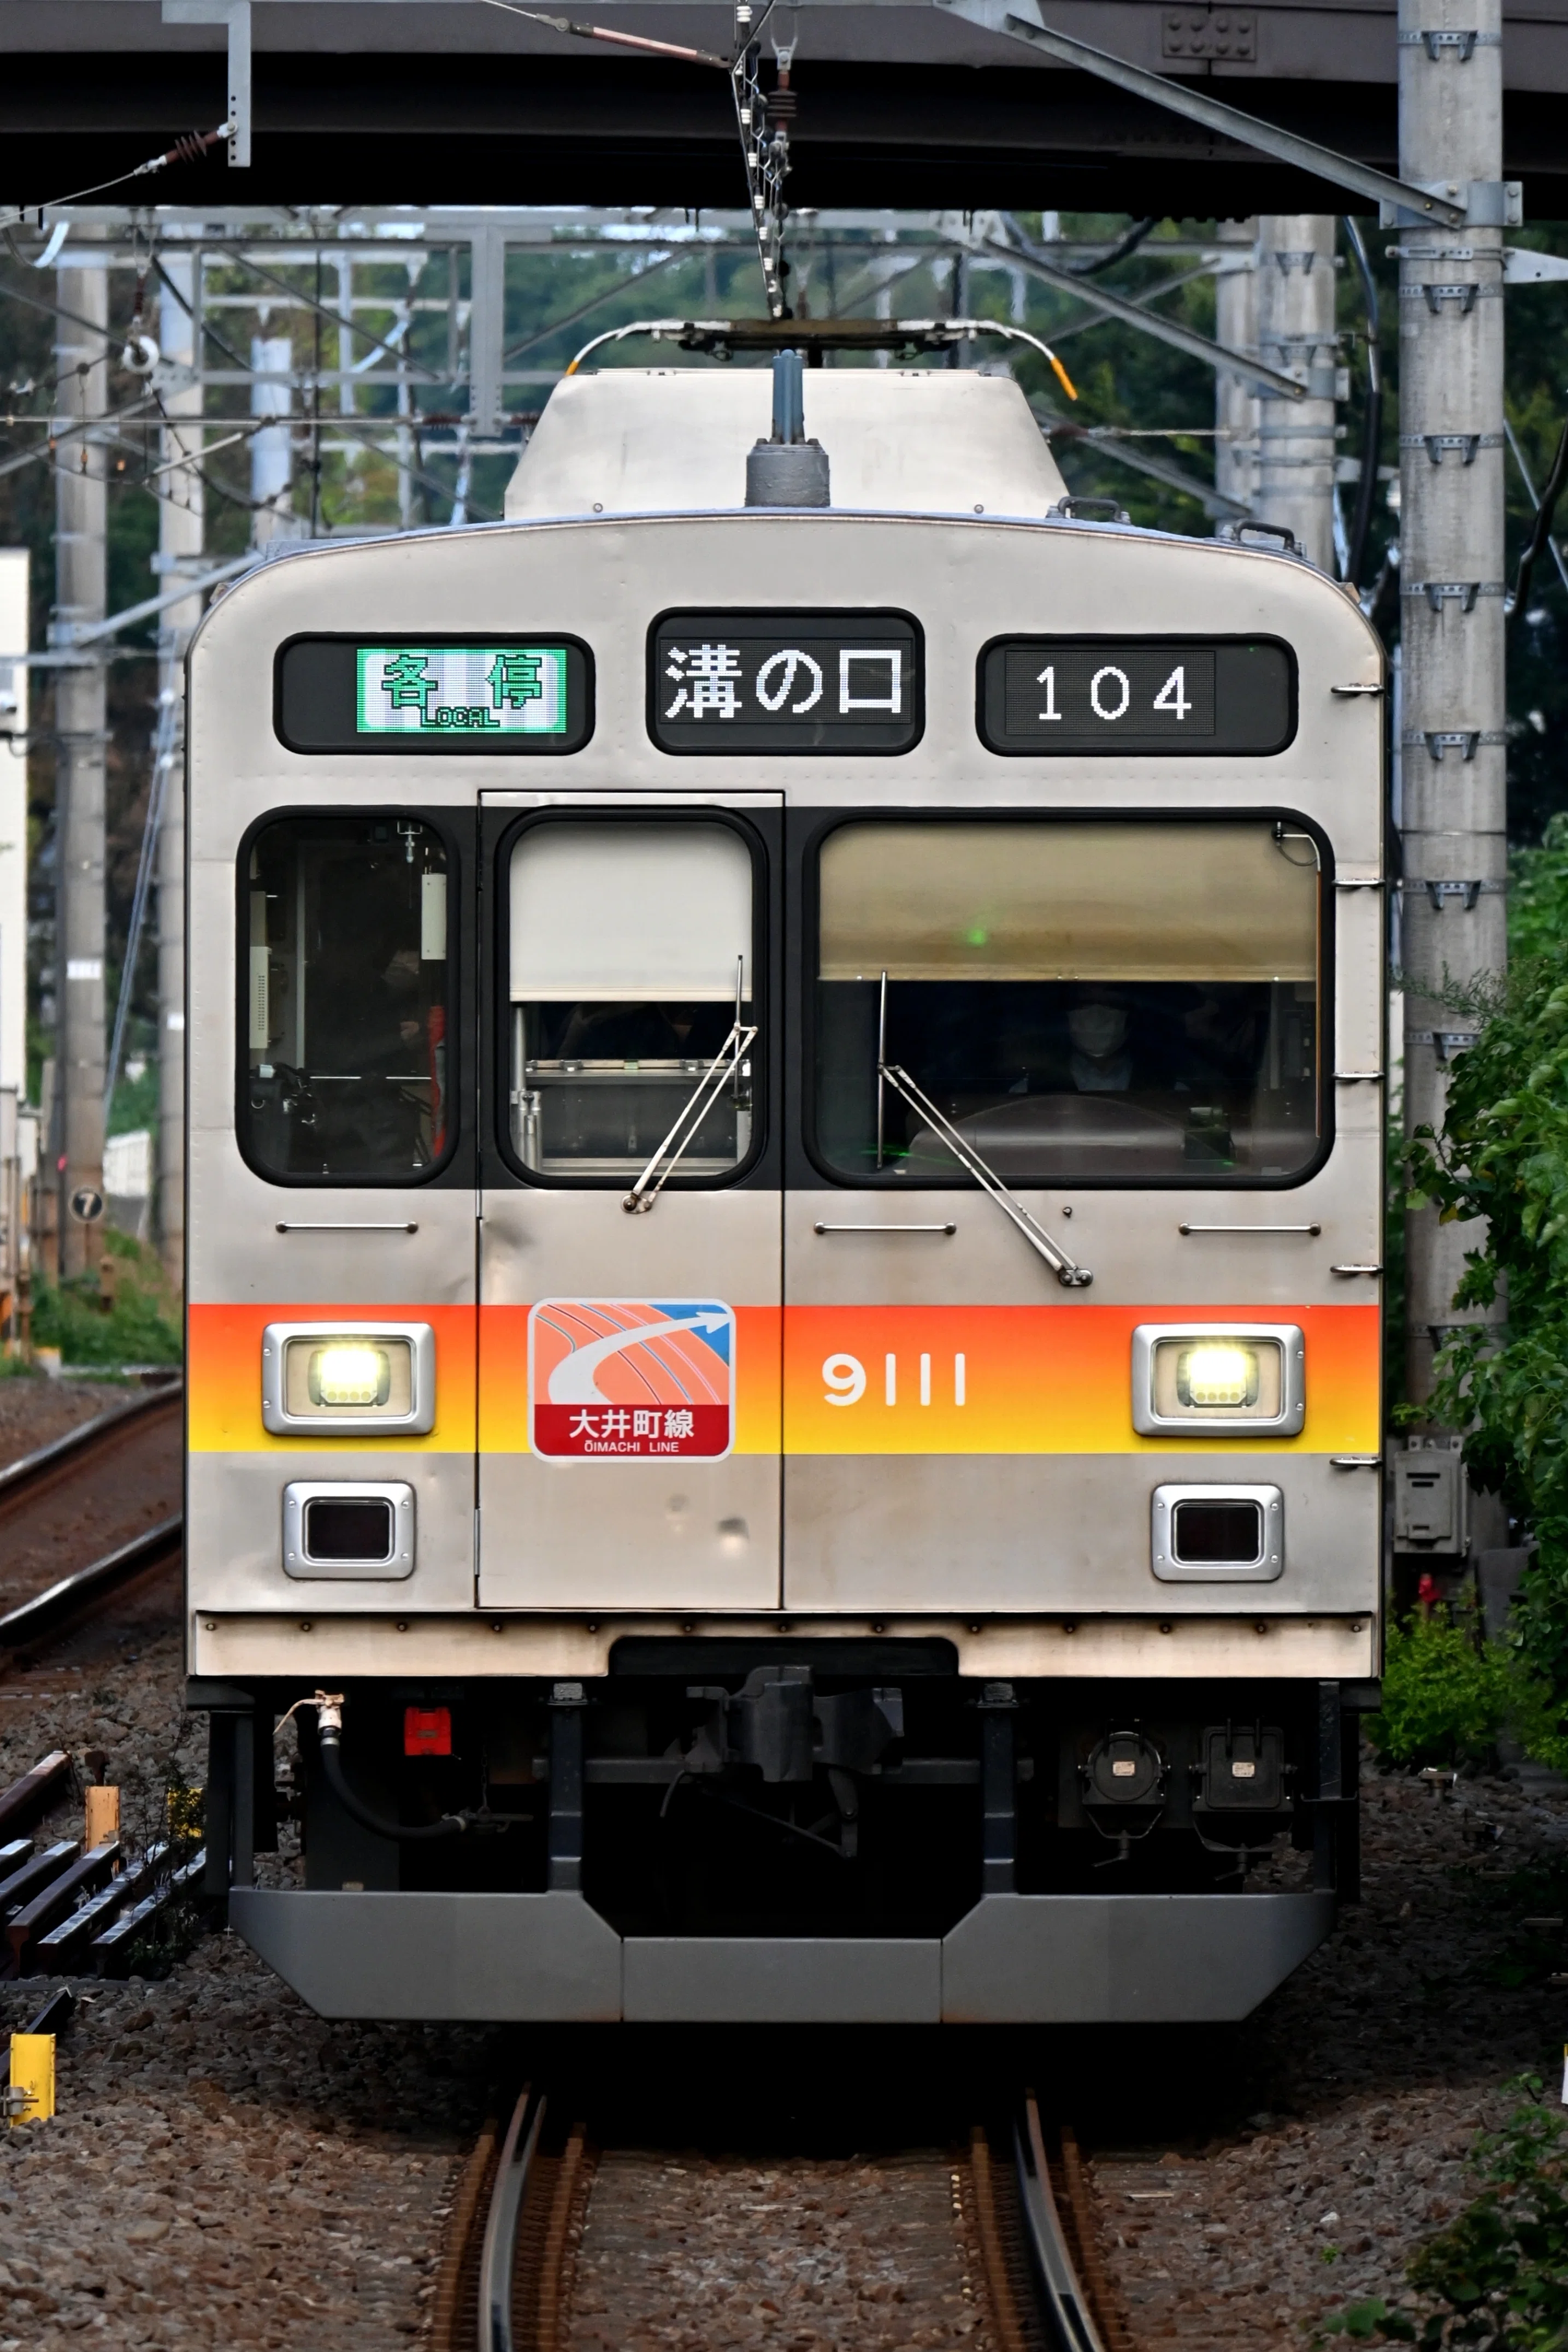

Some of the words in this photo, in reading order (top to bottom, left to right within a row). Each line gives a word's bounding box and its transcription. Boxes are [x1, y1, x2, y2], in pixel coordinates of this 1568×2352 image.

[381, 655, 543, 710] 各停
[665, 645, 902, 719] 溝の口
[1036, 667, 1192, 720] 104
[420, 706, 501, 727] LOCAL
[822, 1353, 965, 1406] 9111
[569, 1409, 694, 1439] 大井町線
[649, 1442, 680, 1453] LINE
